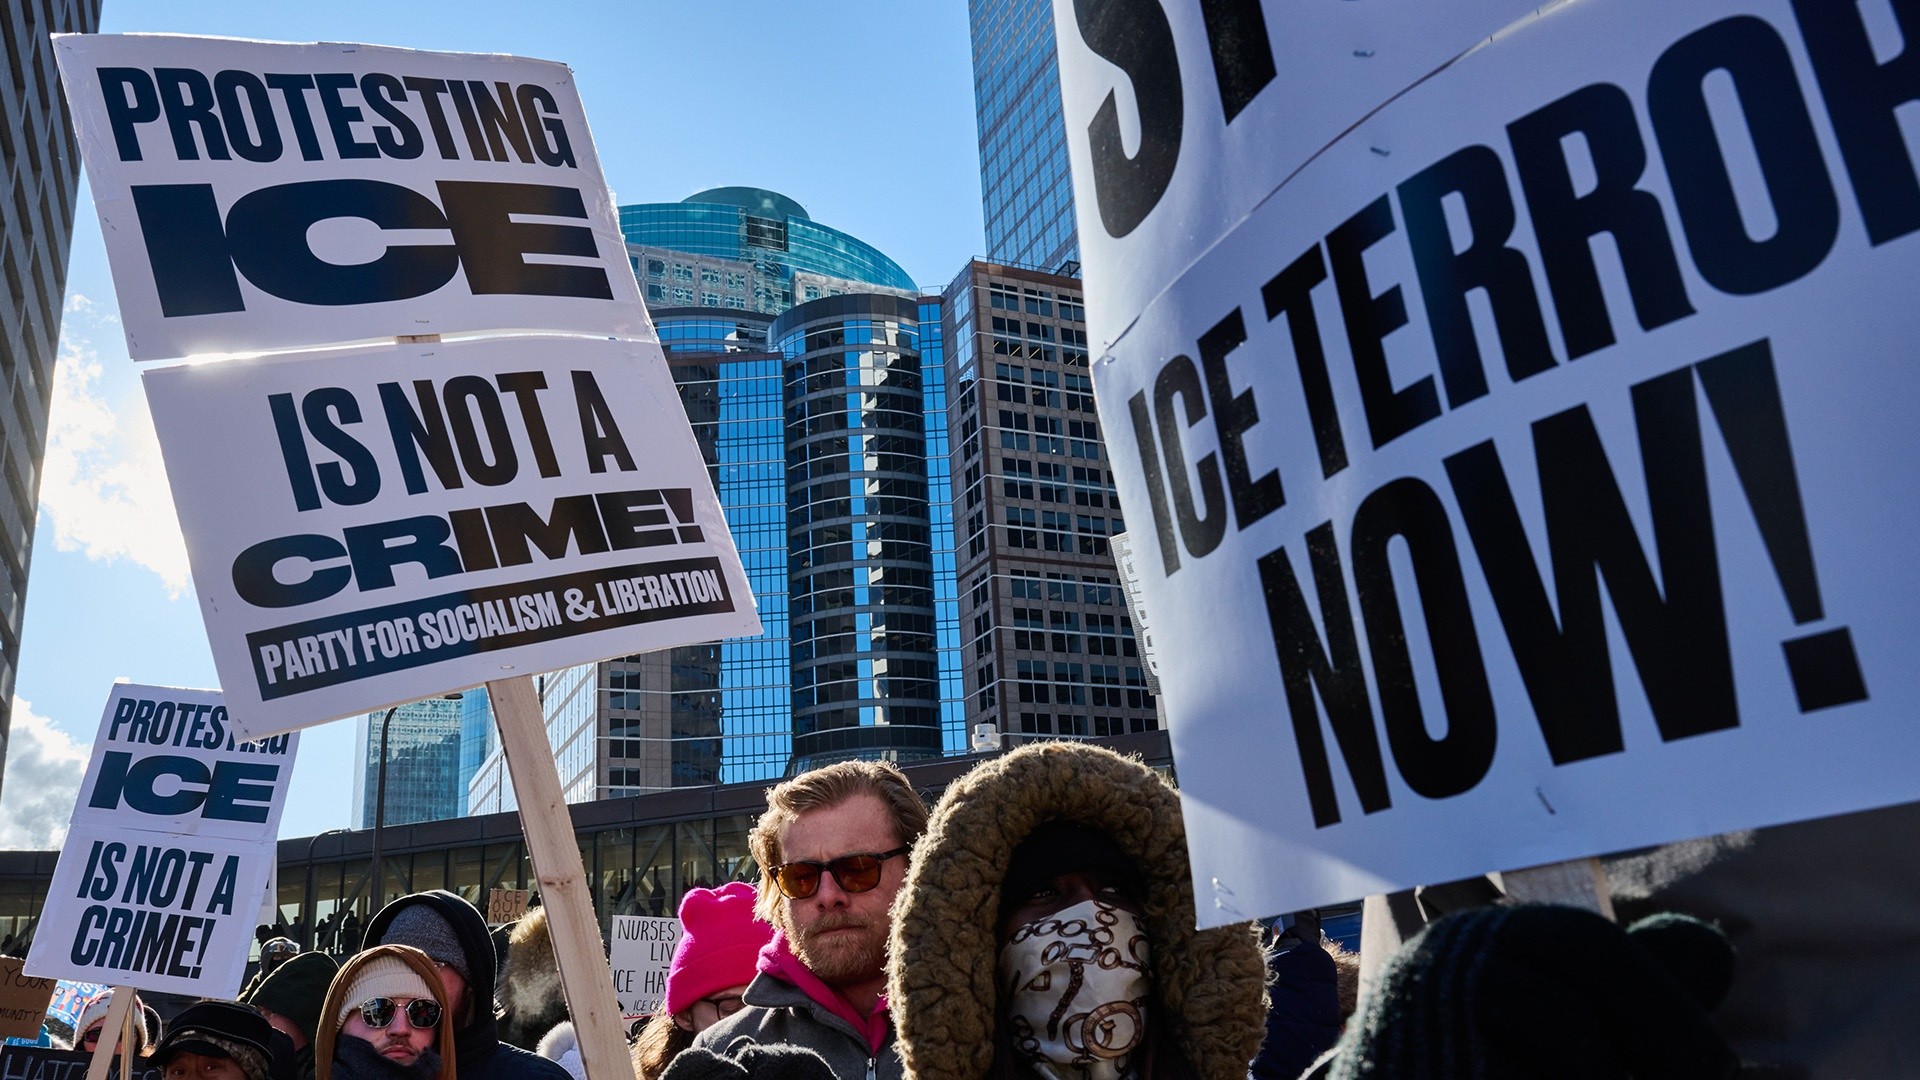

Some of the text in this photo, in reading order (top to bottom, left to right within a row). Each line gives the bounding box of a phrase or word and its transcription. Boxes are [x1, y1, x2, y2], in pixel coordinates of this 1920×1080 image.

[96, 67, 577, 170] PROTESTING
[130, 179, 614, 318] ICE
[267, 370, 638, 512] IS NOT A
[1128, 306, 1286, 578] ICE
[231, 488, 705, 609] CRIME!
[1256, 337, 1870, 829] NOW!
[259, 568, 725, 685] PARTY FOR SOCIALISM & LIBERATION
[107, 697, 289, 755] PROTES
[88, 750, 280, 824] ICE
[76, 840, 240, 915] IS NOT A
[492, 900, 520, 913] OUT
[493, 890, 521, 902] ICE
[70, 904, 216, 979] CRIME!
[493, 912, 519, 923] NO
[618, 919, 676, 942] NURSES
[650, 942, 676, 962] LIV
[613, 969, 669, 994] ICE HA
[633, 999, 647, 1012] ICE
